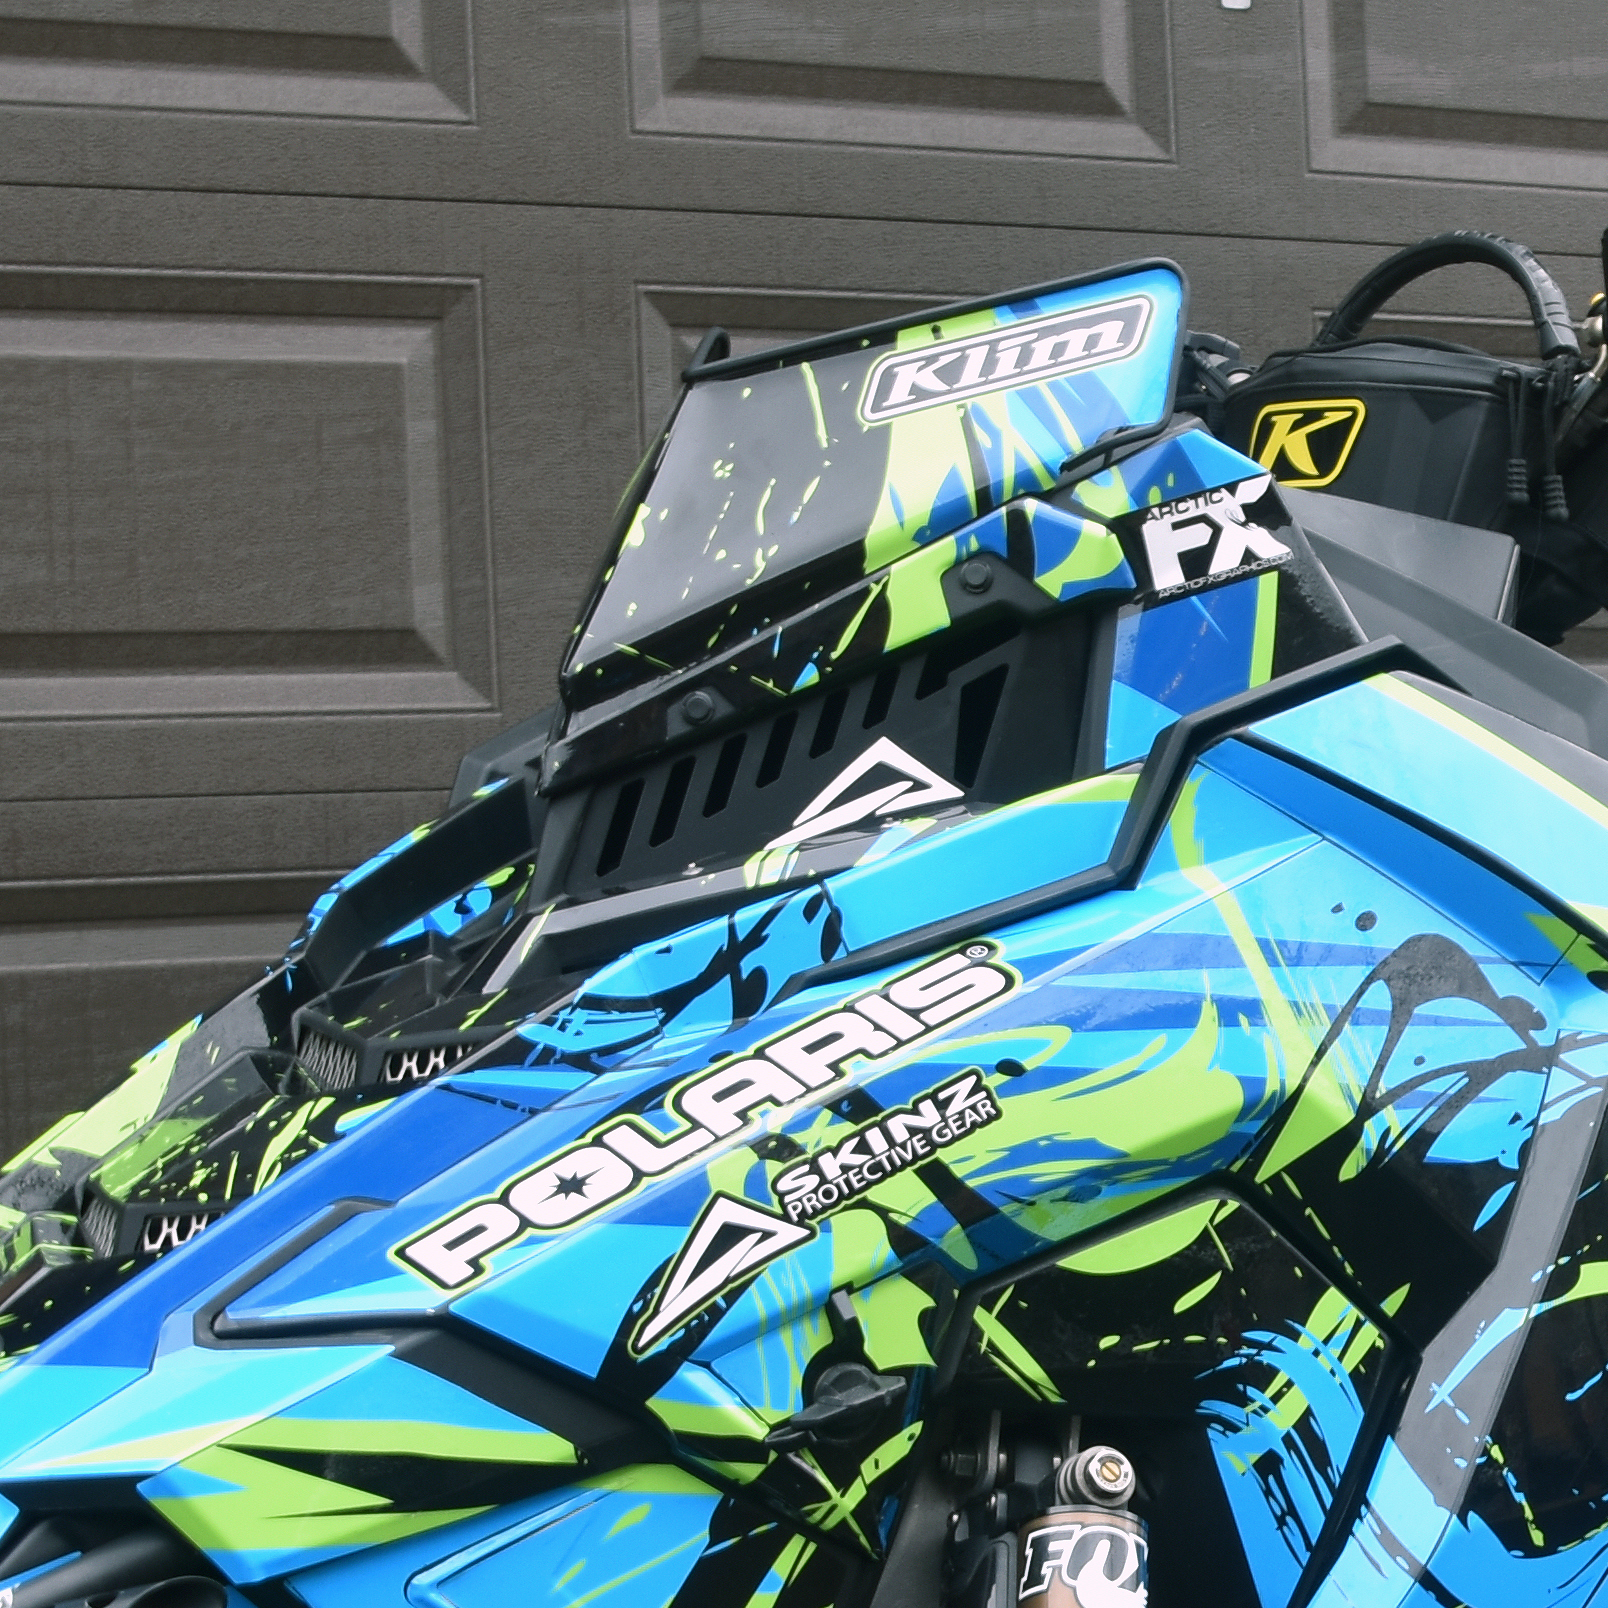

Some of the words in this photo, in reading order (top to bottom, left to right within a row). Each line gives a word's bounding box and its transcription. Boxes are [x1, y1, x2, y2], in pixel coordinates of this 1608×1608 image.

[1259, 410, 1354, 477] K
[1141, 474, 1292, 591] FX
[1144, 487, 1226, 524] ARCTIC
[405, 952, 1015, 1288] POLARIS
[776, 1074, 988, 1203] SKINZ
[786, 1133, 932, 1223] PROTECTIVE
[932, 1099, 997, 1144] GEAR
